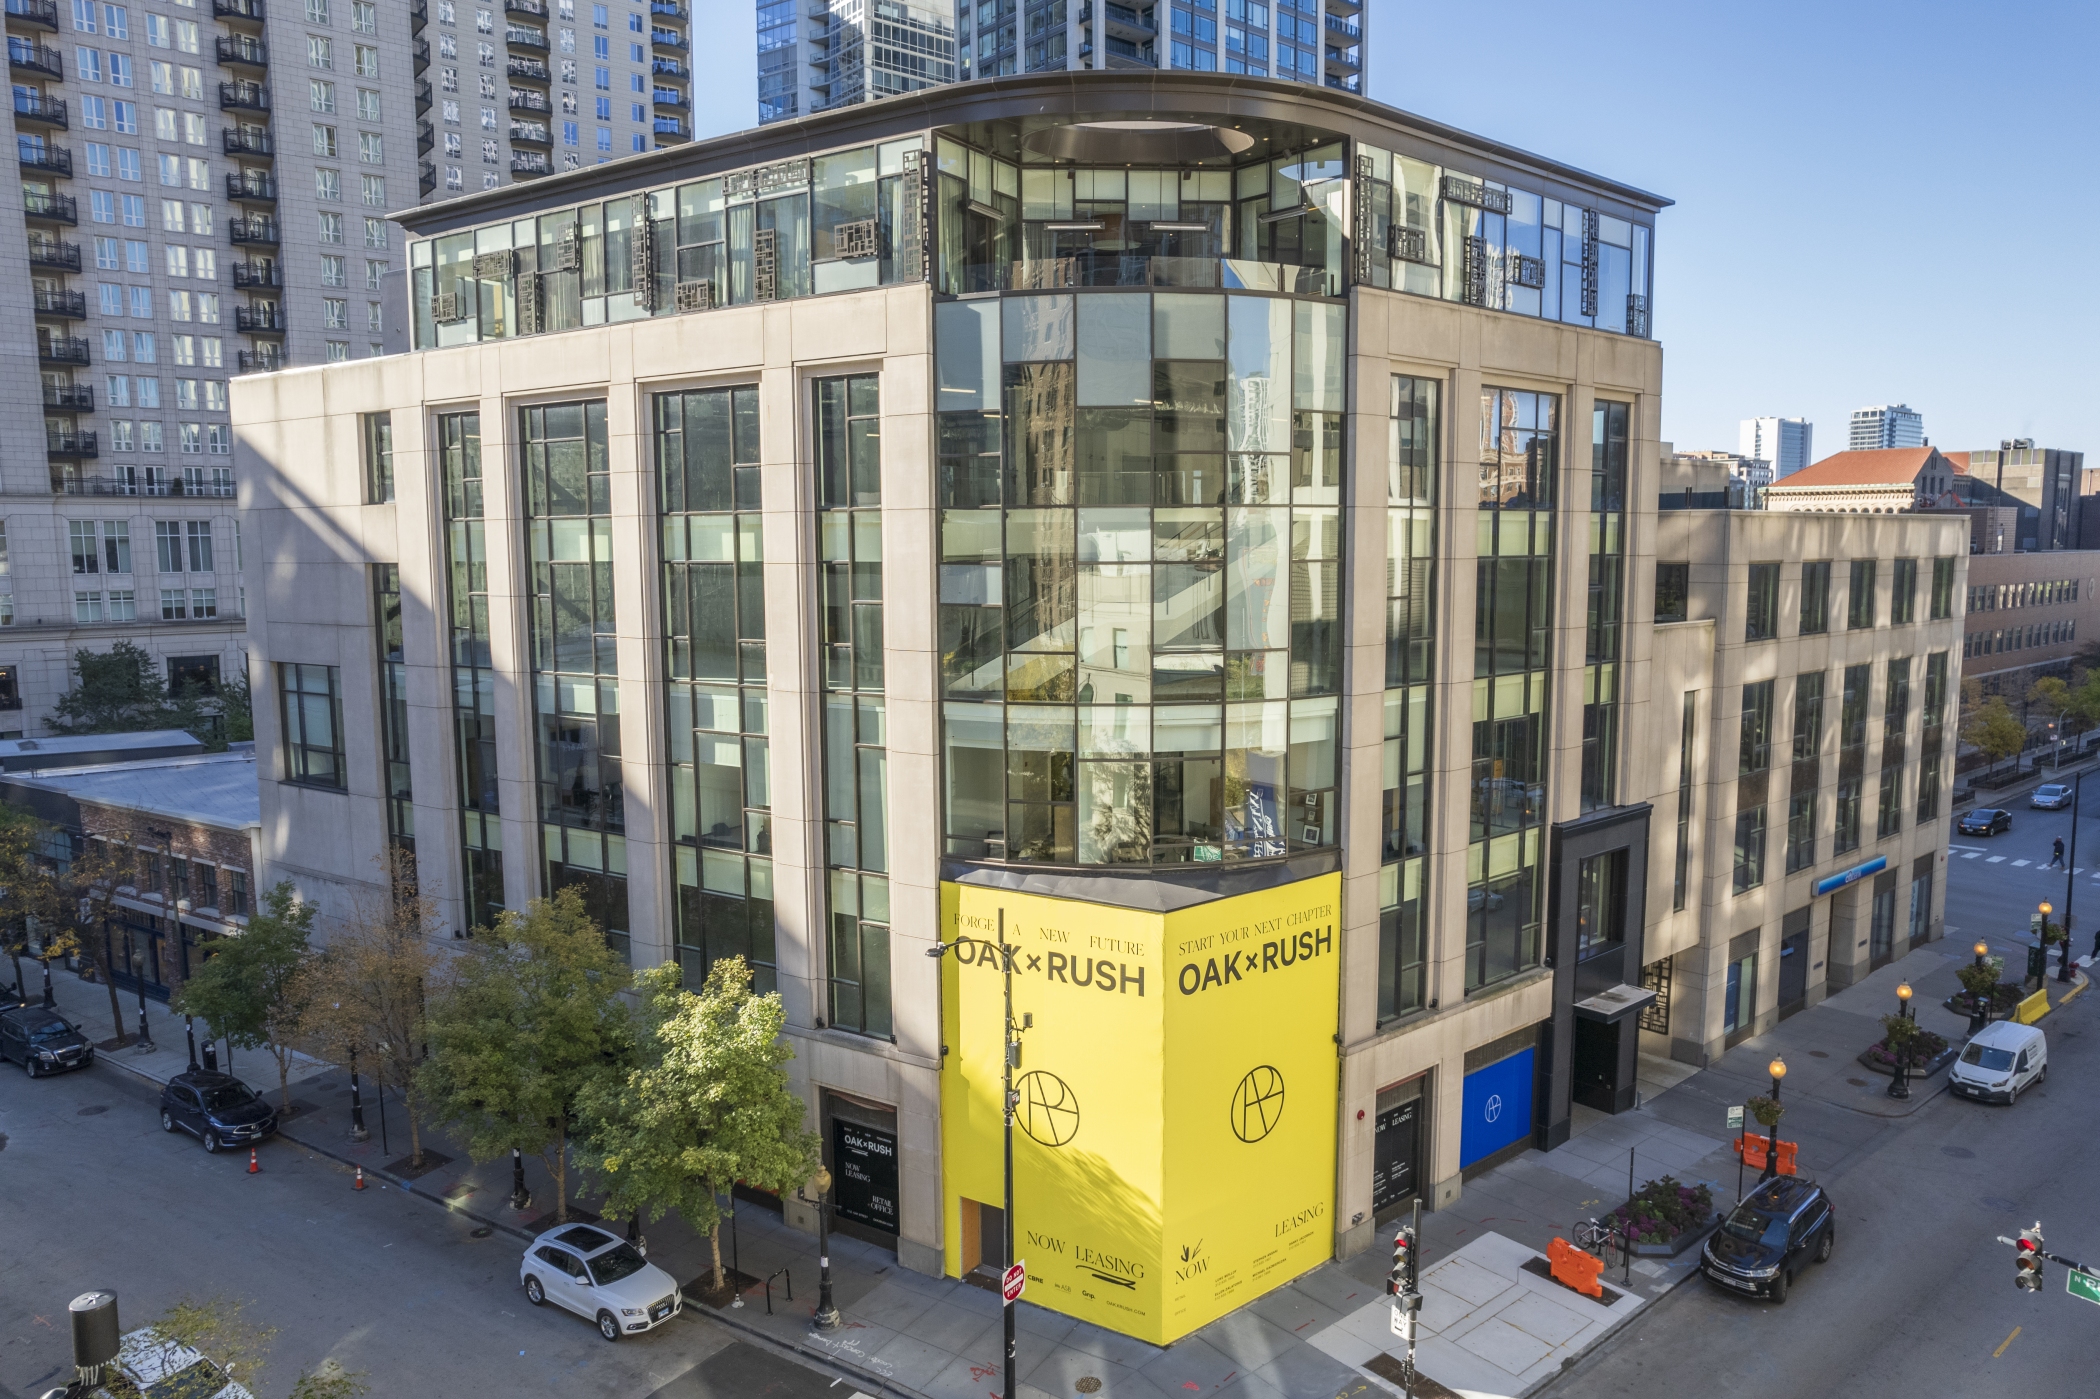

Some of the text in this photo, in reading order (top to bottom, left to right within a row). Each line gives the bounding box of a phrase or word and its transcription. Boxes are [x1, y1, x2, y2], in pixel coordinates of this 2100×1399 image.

[954, 913, 1145, 956] FORGE A NEW FUTURE
[1178, 904, 1332, 956] START YOUR NEXT CHAPTER
[845, 1161, 861, 1172] NOW
[845, 1169, 871, 1183] LEASING
[870, 1202, 894, 1216] OFFICE
[872, 1195, 893, 1208] RETAIL
[1275, 1202, 1324, 1238] LEASING
[1027, 1230, 1145, 1279] NOW LEASING
[1006, 1268, 1022, 1284] DO NOT
[1175, 1256, 1211, 1285] NOW
[2074, 1275, 2081, 1283] N
[1006, 1283, 1022, 1298] ENTER
